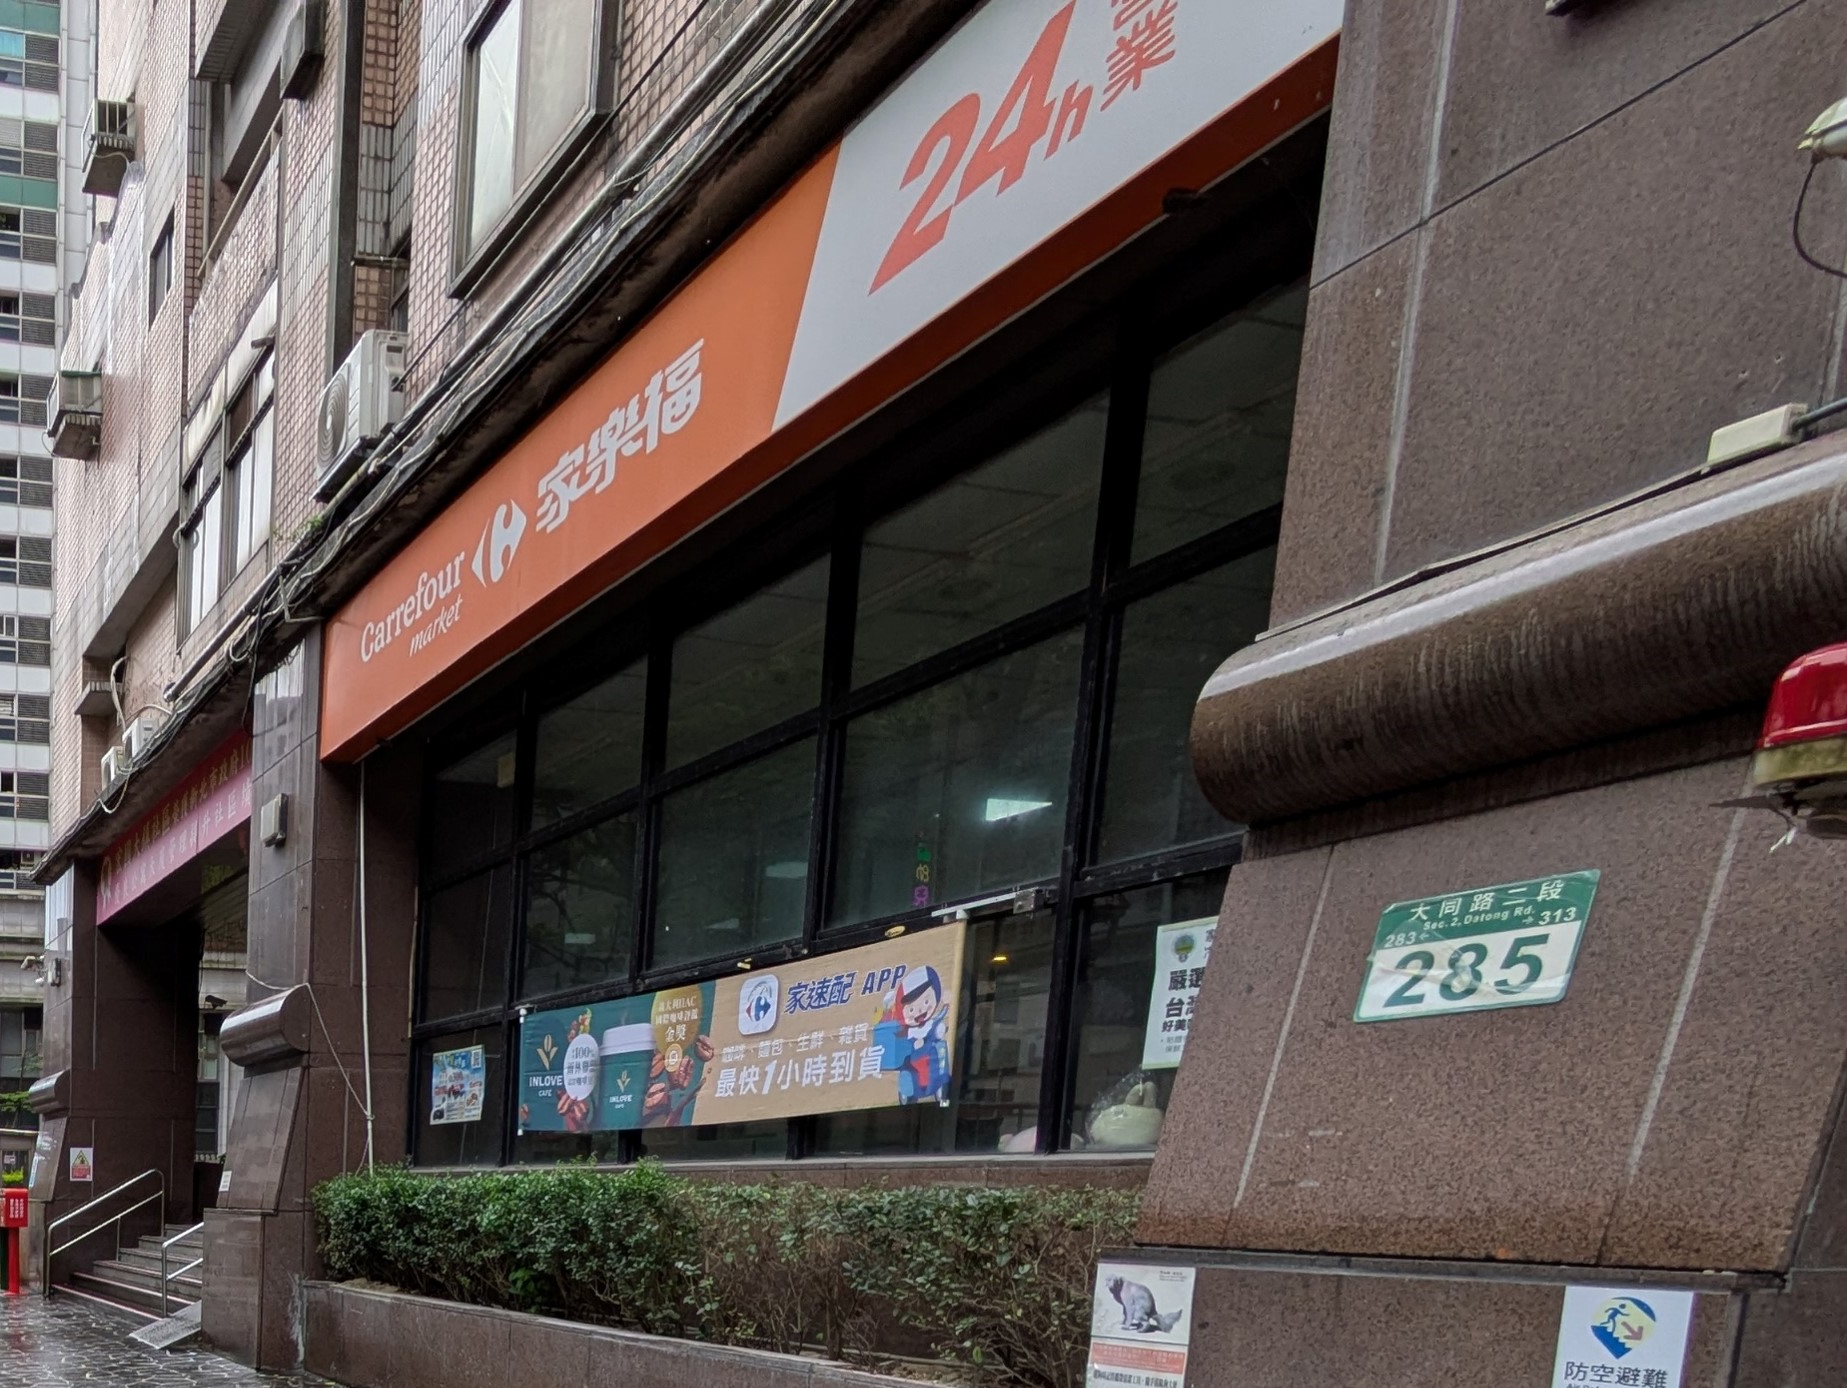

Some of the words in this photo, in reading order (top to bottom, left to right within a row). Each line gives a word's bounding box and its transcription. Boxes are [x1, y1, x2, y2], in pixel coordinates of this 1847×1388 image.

[536, 338, 704, 533] 家樂福
[360, 551, 465, 663] Carrefour
[409, 595, 463, 657] market
[1410, 879, 1565, 922] 大同路二段
[1423, 918, 1449, 932] Sec.
[1463, 910, 1510, 926] Datong
[1513, 905, 1536, 917] Rd.
[1538, 906, 1578, 926] 313
[1383, 931, 1418, 949] 283
[783, 971, 858, 1015] 家速配
[861, 964, 908, 996] APP
[1382, 933, 1552, 1009] 285
[529, 1075, 563, 1087] INLOVE
[715, 1045, 886, 1098] 最快1小時到貨
